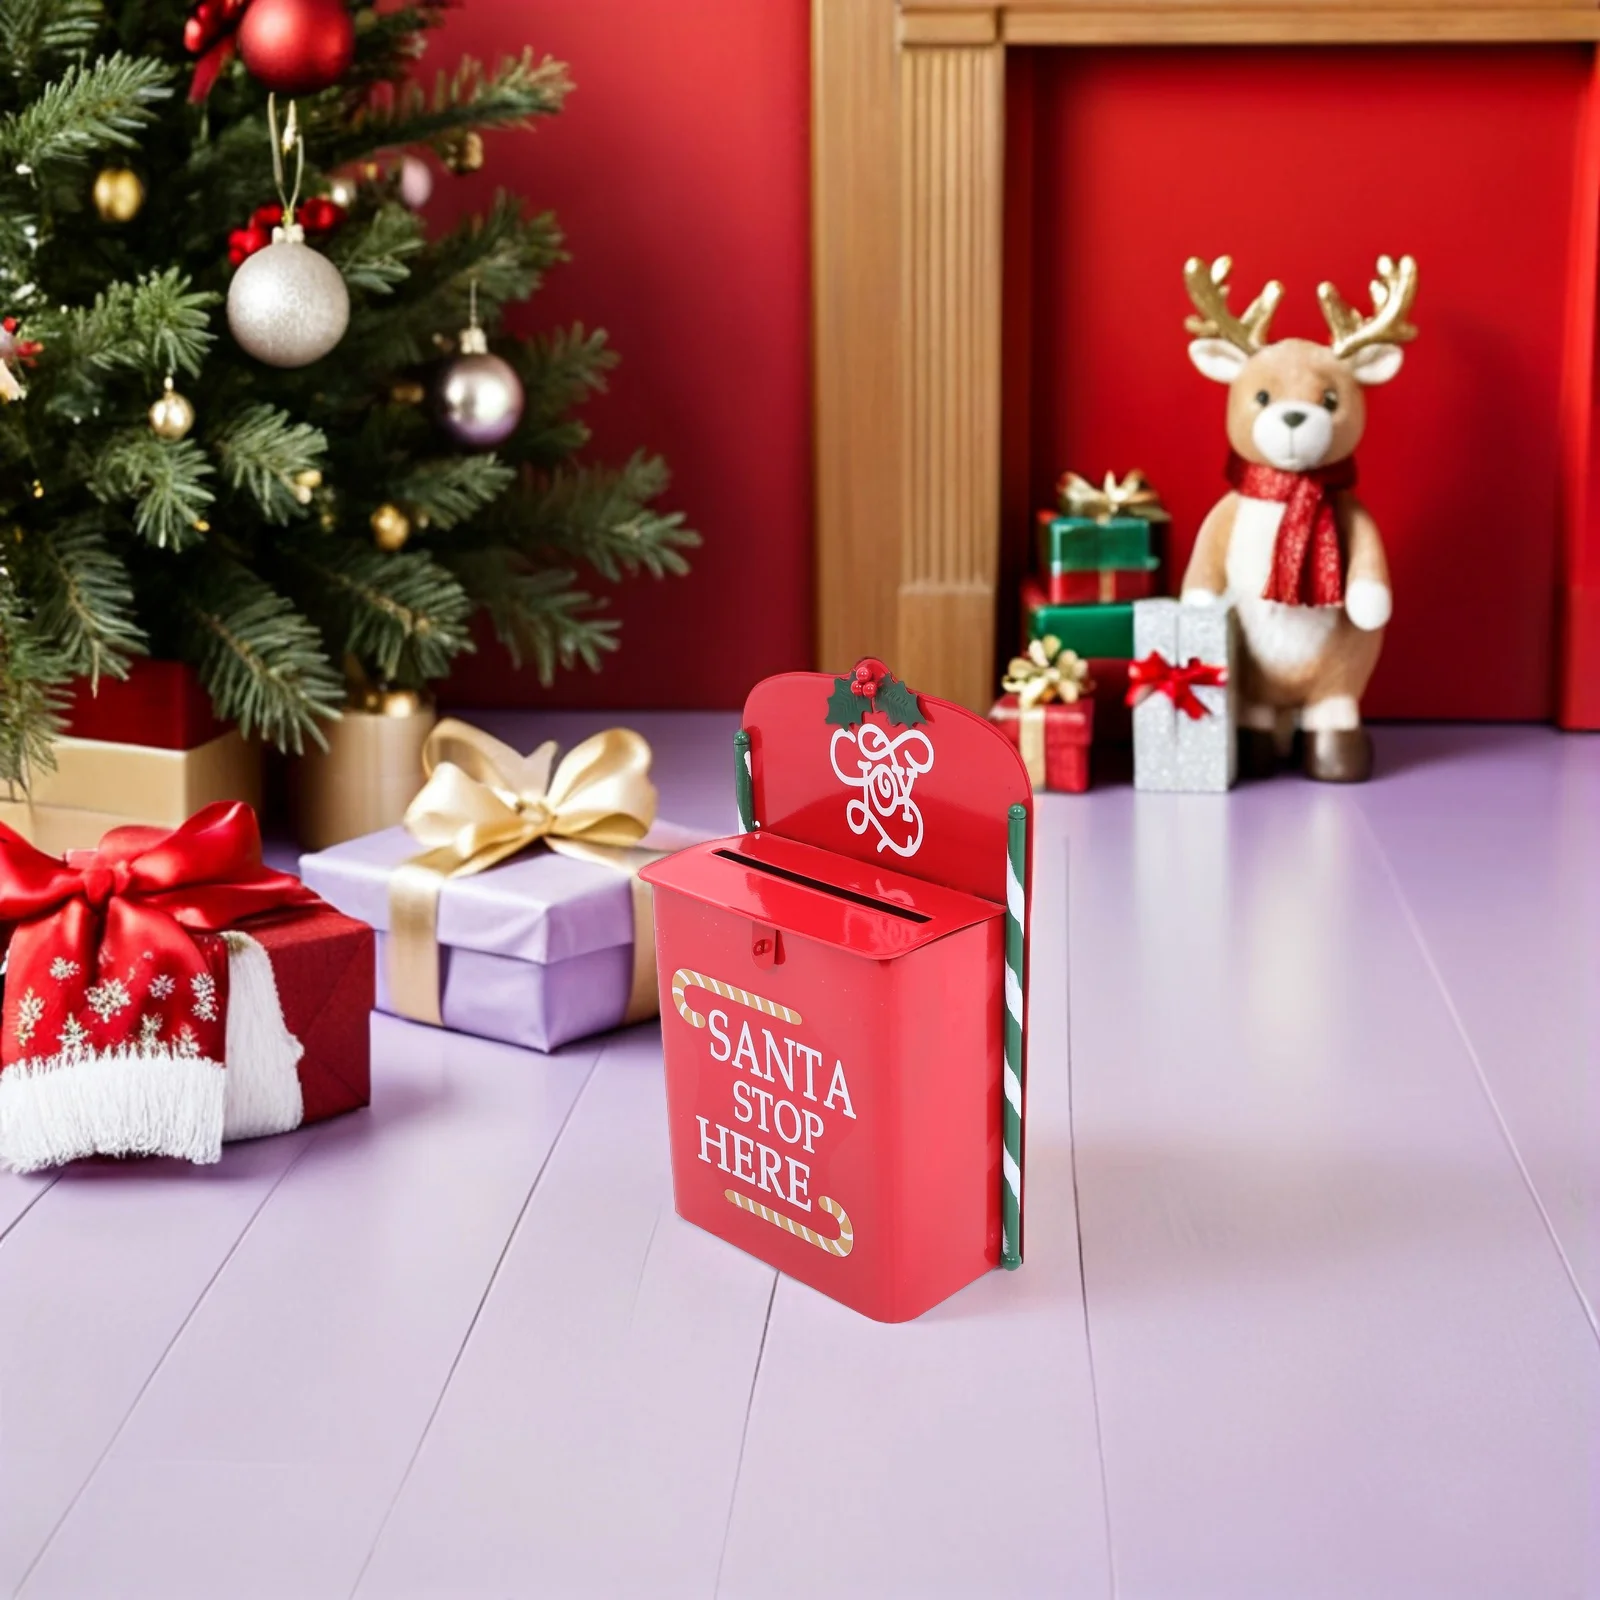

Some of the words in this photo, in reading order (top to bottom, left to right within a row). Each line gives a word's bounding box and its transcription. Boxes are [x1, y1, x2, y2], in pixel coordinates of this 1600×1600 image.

[708, 1009, 857, 1120] SANTA
[695, 1114, 812, 1213] HERE
[733, 1080, 825, 1154] STOP
